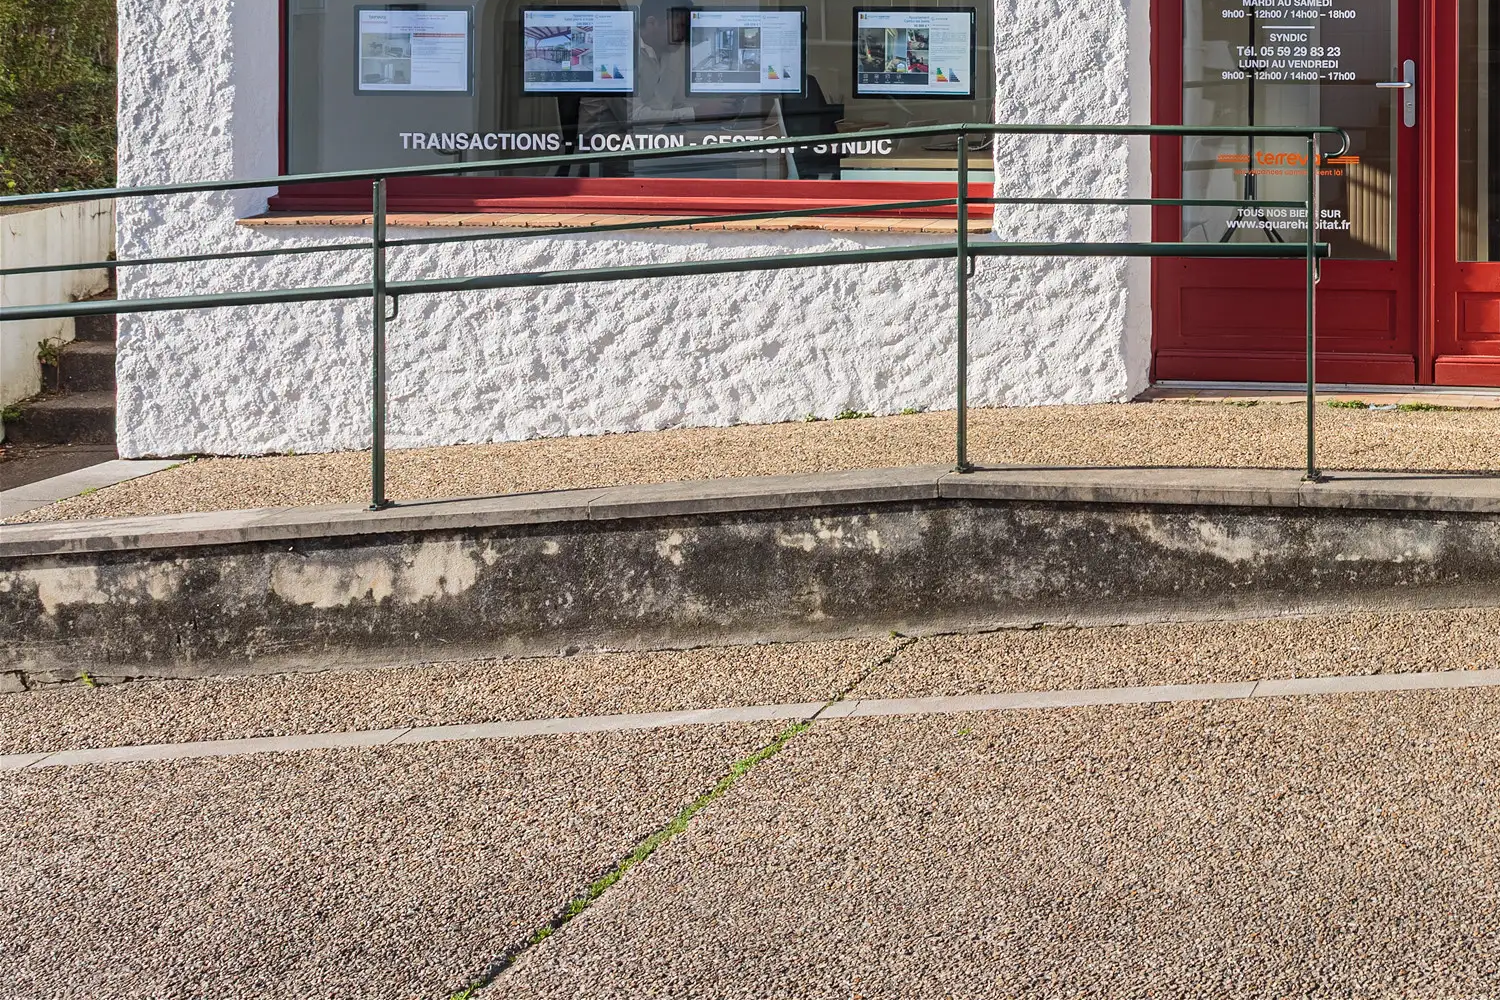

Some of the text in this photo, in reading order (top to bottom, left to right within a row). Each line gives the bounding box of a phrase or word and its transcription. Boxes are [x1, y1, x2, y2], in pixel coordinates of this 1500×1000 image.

[1222, 10, 1244, 19] 9h00
[1254, 10, 1282, 19] 12h00
[1291, 10, 1318, 19] 14h00
[1328, 10, 1356, 19] 18h00
[1270, 34, 1307, 42] SYNDIC
[1237, 46, 1341, 56] Tél. 05 59 29 83 23
[1239, 60, 1339, 68] LUNDI AU VENDREDI
[1222, 72, 1244, 80] 9h00
[1254, 72, 1282, 80] 12h00
[1291, 72, 1318, 80] 14h00
[1328, 72, 1356, 80] 17h00
[399, 132, 560, 151] TRANSACTIONS
[578, 133, 684, 152] LOCATION
[1237, 209, 1341, 218] TOUS NOS BIE SUR
